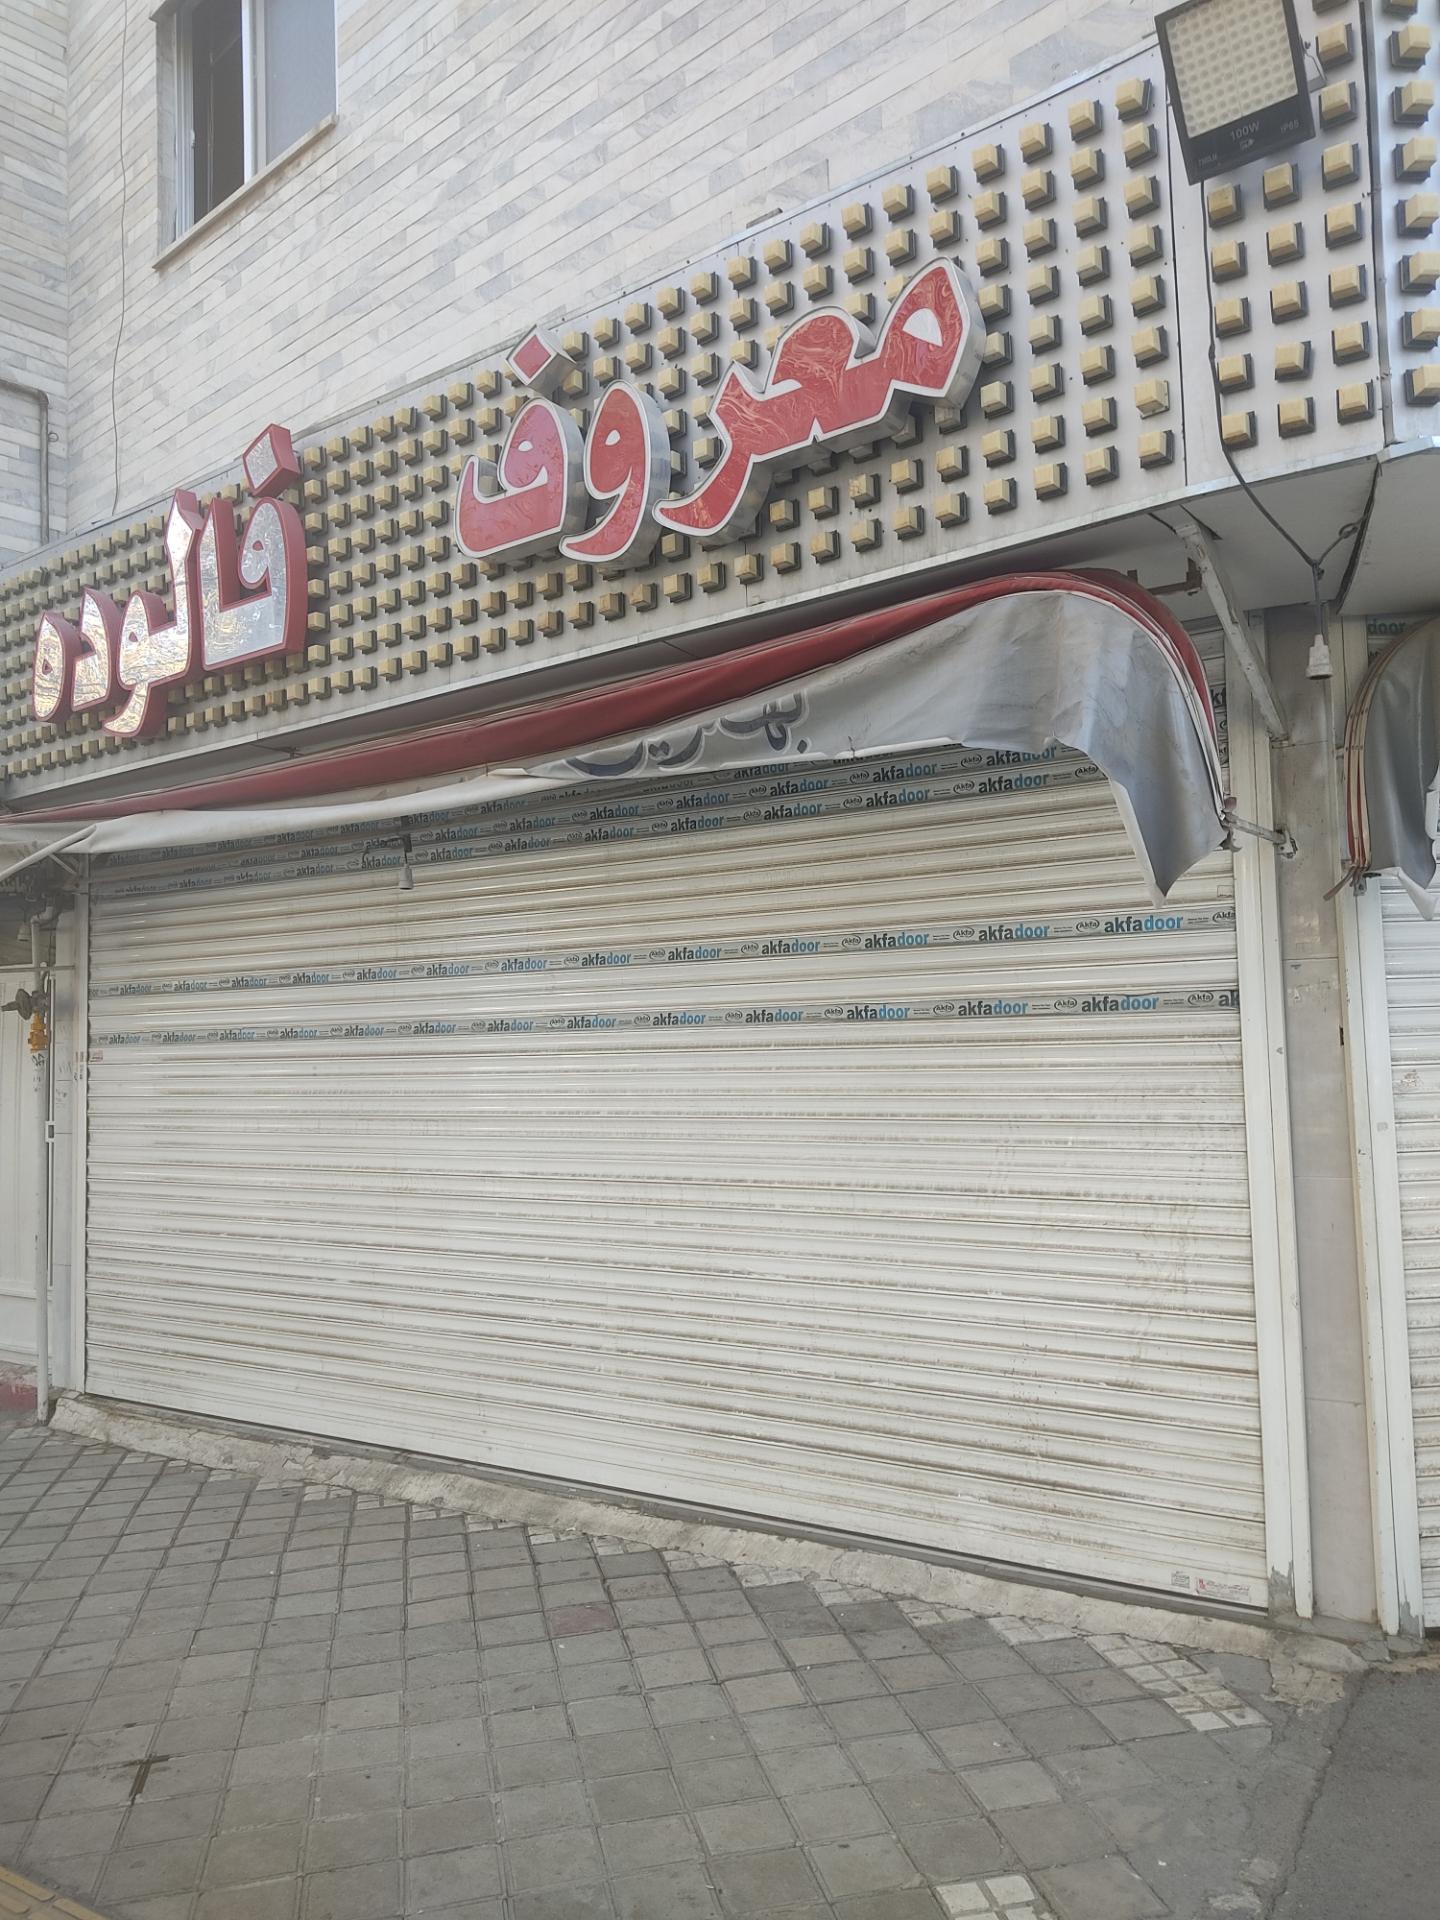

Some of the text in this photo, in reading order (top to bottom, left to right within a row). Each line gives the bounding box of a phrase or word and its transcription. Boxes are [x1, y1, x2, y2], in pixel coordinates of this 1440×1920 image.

[1230, 121, 1260, 141] 100W
[32, 257, 984, 738] معروف فالوده
[361, 855, 401, 869] akfadoor
[430, 847, 473, 861] akfadoor
[504, 838, 551, 852] akfadoor
[584, 825, 634, 843] akfadoor
[670, 815, 724, 832] akfadoor
[763, 802, 822, 821] akfadoor
[865, 787, 930, 807] akfadoor
[978, 773, 1049, 793] akfadoor
[435, 825, 479, 841] akfadoor
[509, 815, 556, 832] akfadoor
[589, 803, 640, 821] akfadoor
[676, 791, 730, 809] akfadoor
[769, 777, 829, 797] akfadoor
[872, 762, 937, 783] akfadoor
[293, 972, 329, 985] akfadoor
[357, 968, 397, 980] akfadoor
[426, 963, 470, 976] akfadoor
[501, 958, 547, 972] akfadoor
[581, 951, 632, 966] akfadoor
[668, 946, 722, 961] akfadoor
[761, 939, 820, 955] akfadoor
[864, 932, 929, 950] akfadoor
[978, 923, 1050, 942] akfadoor
[1104, 915, 1184, 934] akfadoor
[280, 1027, 317, 1039] akfadoor
[344, 1025, 384, 1037] akfadoor
[413, 1022, 456, 1035] akfadoor
[487, 1018, 533, 1032] akfadoor
[567, 1015, 616, 1030] akfadoor
[653, 1011, 706, 1027] akfadoor
[745, 1008, 804, 1024] akfadoor
[846, 1003, 910, 1021] akfadoor
[958, 1000, 1028, 1017] akfadoor
[1082, 995, 1159, 1013] akfadoor
